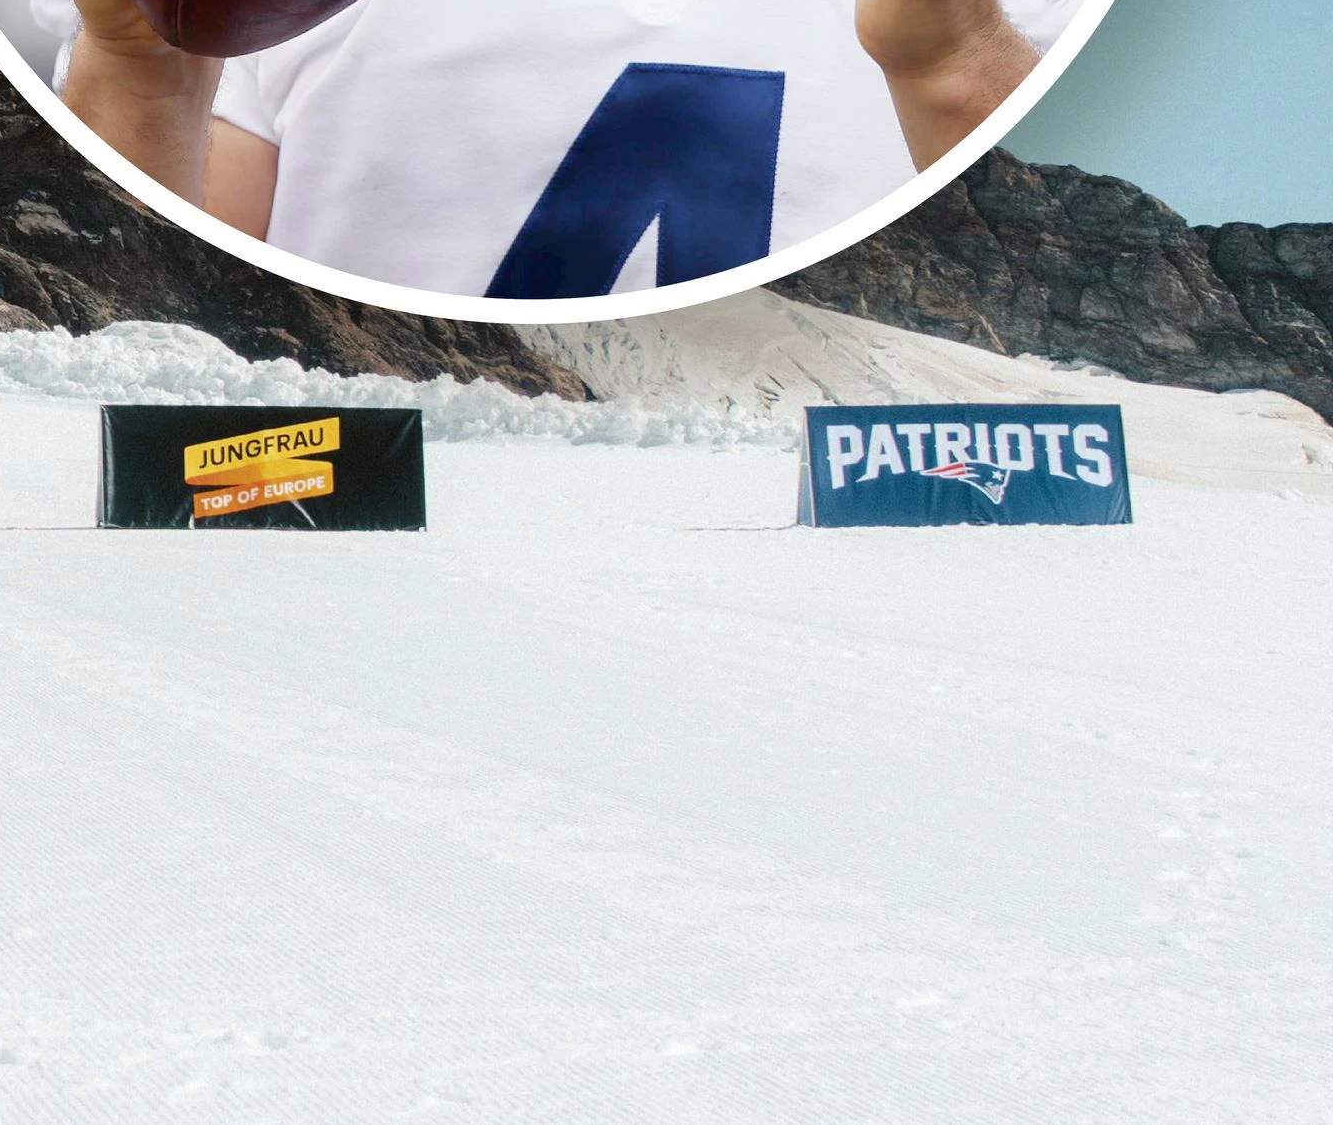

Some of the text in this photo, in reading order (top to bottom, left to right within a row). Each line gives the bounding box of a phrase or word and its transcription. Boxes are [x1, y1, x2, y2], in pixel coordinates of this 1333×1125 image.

[483, 62, 786, 300] 4
[199, 427, 324, 469] JUNGFRAU
[826, 423, 1113, 489] PATRIOTS
[201, 476, 325, 510] TOP OF EUROPE
